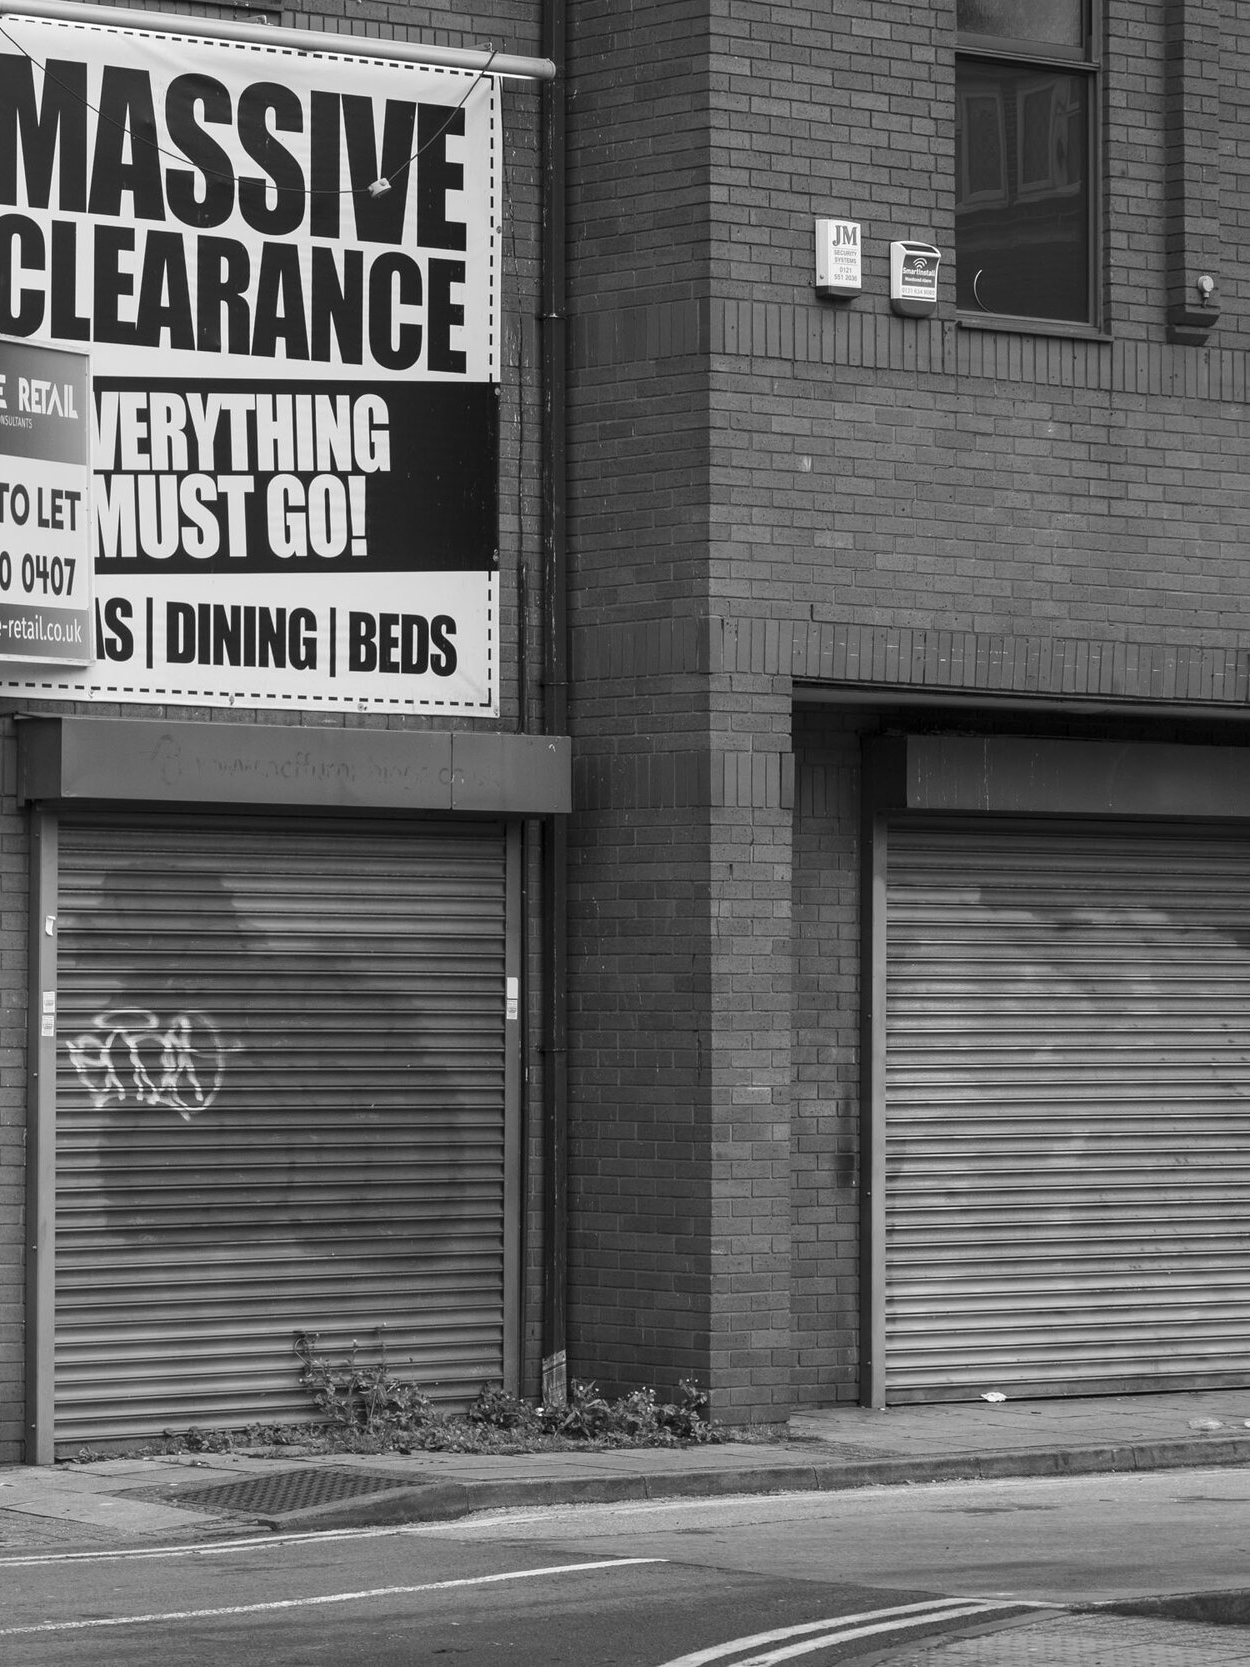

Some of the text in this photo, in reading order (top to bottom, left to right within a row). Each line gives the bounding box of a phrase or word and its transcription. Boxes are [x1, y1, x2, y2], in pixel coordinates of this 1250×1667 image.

[832, 225, 857, 247] JM
[834, 256, 857, 264] SYSTEMS
[19, 376, 79, 419] RETAIL
[94, 392, 392, 473] VERYTHING
[37, 486, 81, 531] LET
[95, 473, 367, 560] MUST GO!
[22, 553, 76, 596] 0407
[167, 602, 318, 671] DINING
[350, 610, 458, 677] BEDS
